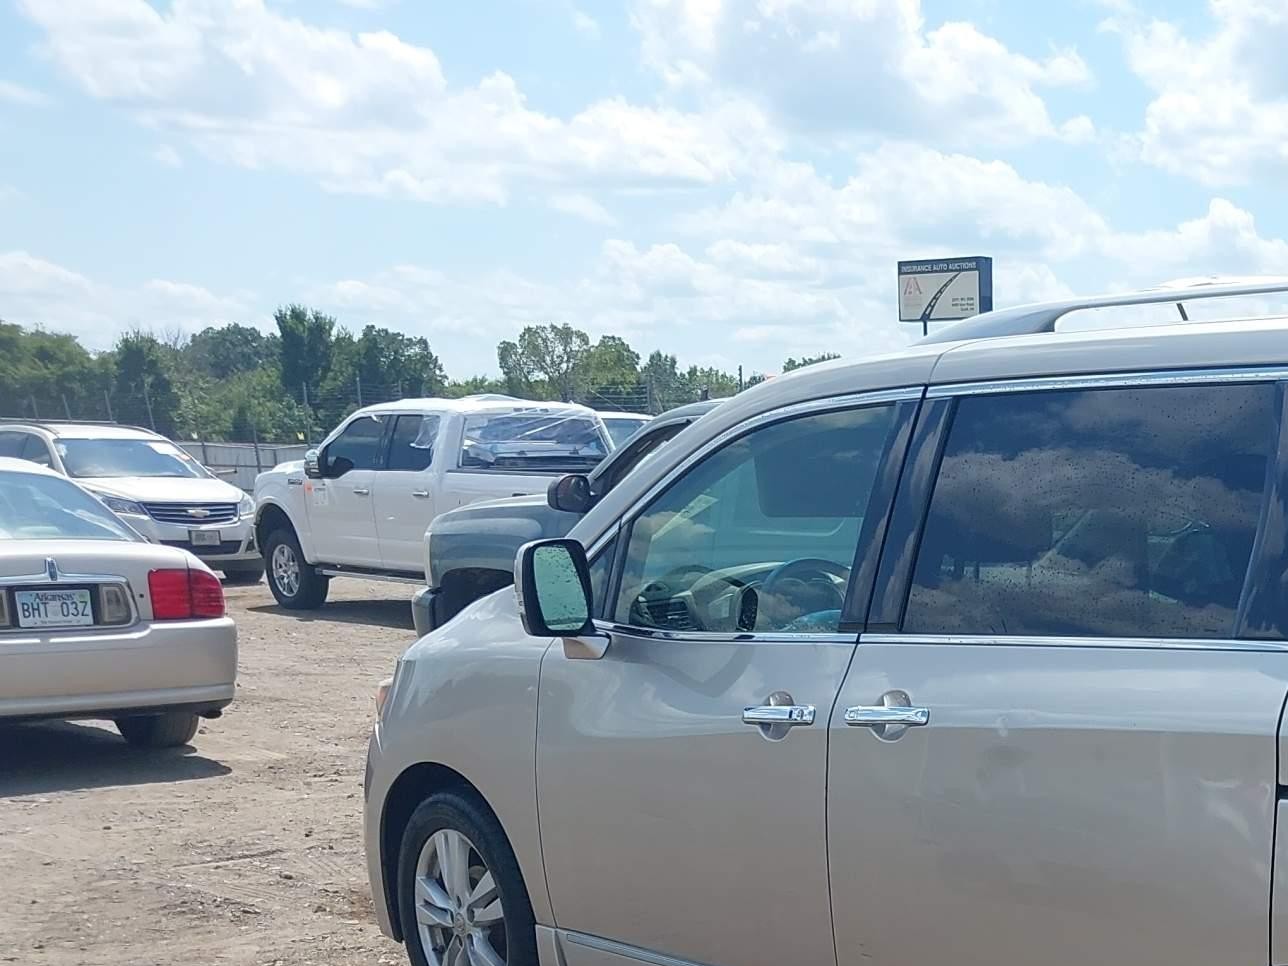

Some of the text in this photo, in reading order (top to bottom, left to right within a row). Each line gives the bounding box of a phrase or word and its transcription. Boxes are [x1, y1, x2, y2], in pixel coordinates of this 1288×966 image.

[932, 263, 948, 271] AUTO
[948, 261, 977, 270] AUCTIONS
[32, 592, 75, 602] Arkansas
[21, 600, 90, 618] BHT 03Z
